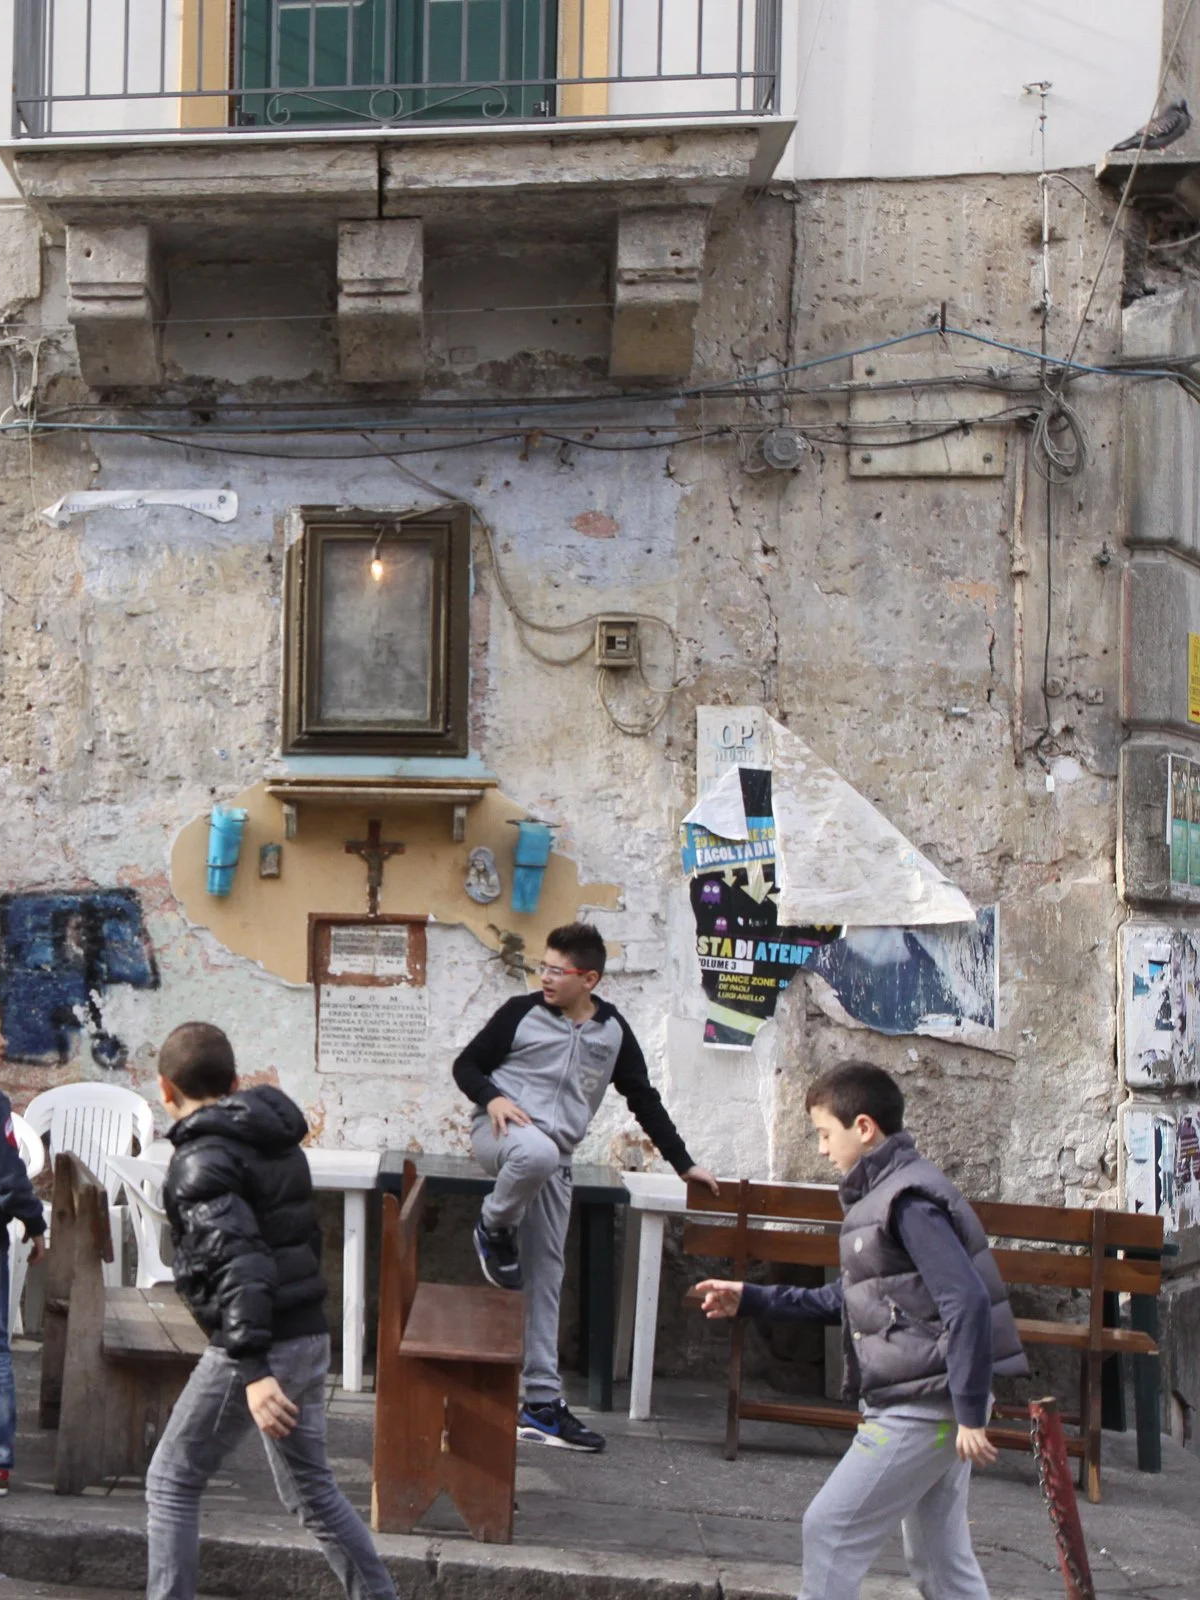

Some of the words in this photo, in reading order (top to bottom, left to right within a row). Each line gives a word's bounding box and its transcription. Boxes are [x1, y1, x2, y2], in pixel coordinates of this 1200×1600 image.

[699, 958, 729, 970] OLUME
[731, 962, 737, 971] 3
[719, 974, 749, 984] DANCE
[751, 977, 776, 988] ZONE
